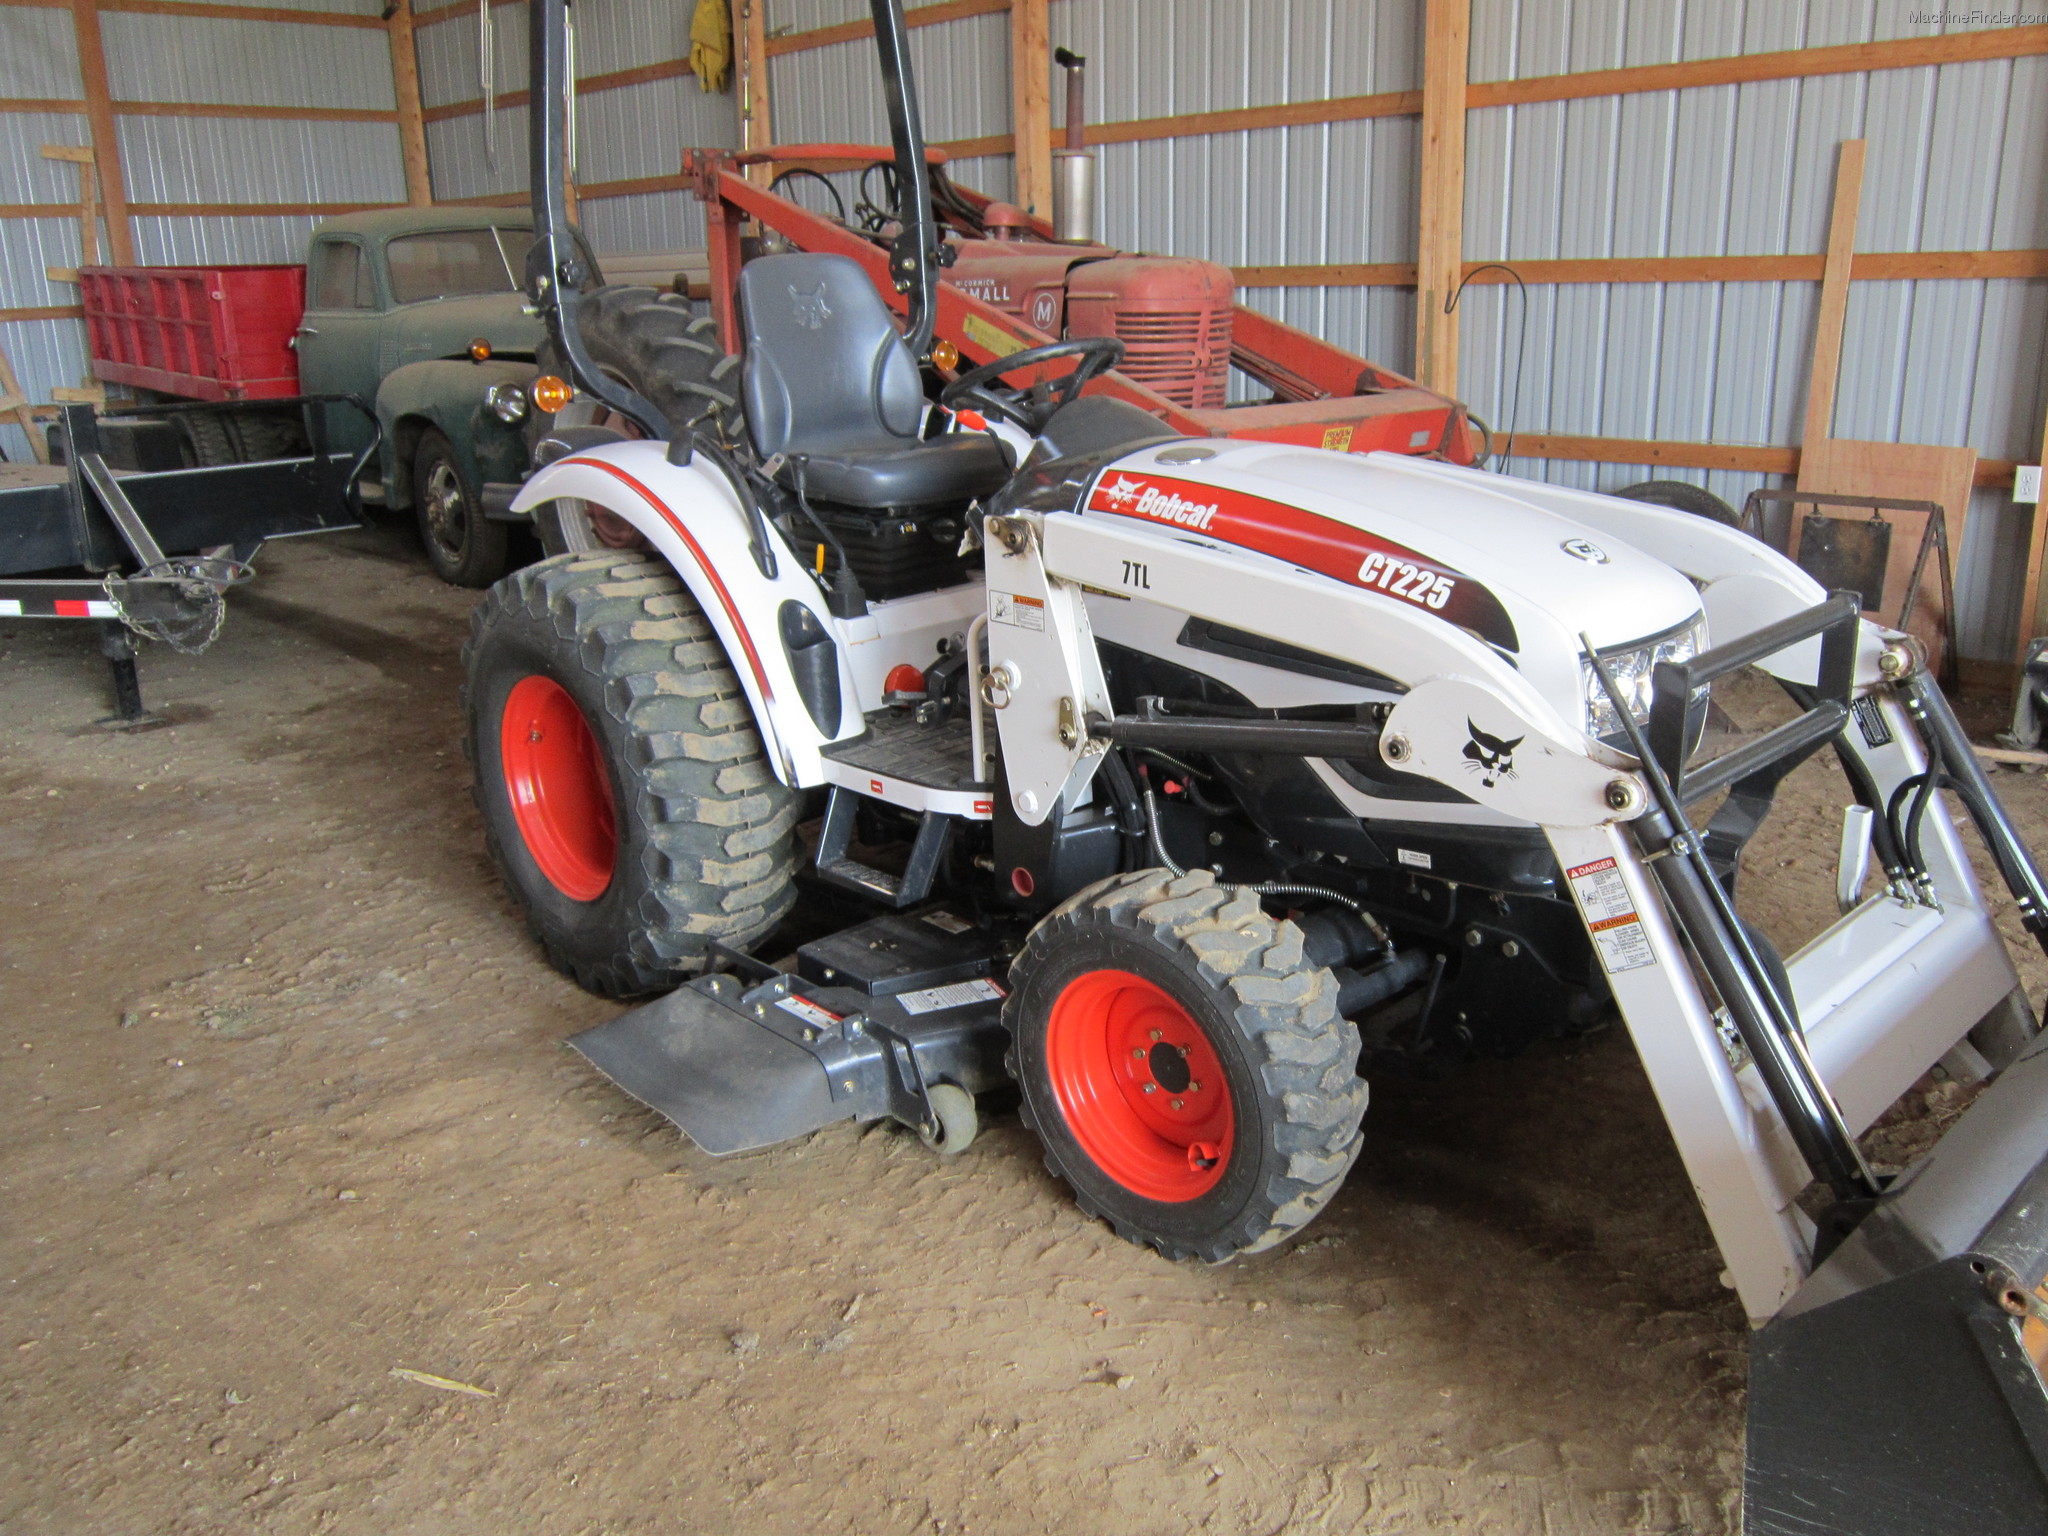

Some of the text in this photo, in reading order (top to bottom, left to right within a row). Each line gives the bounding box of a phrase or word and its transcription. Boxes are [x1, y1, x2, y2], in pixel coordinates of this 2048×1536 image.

[1037, 302, 1051, 322] M
[1135, 487, 1218, 530] Bobcat
[1122, 560, 1150, 589] 7TL
[1358, 552, 1455, 609] CT225
[1578, 859, 1614, 876] DANGER
[1599, 914, 1636, 928] WARNING
